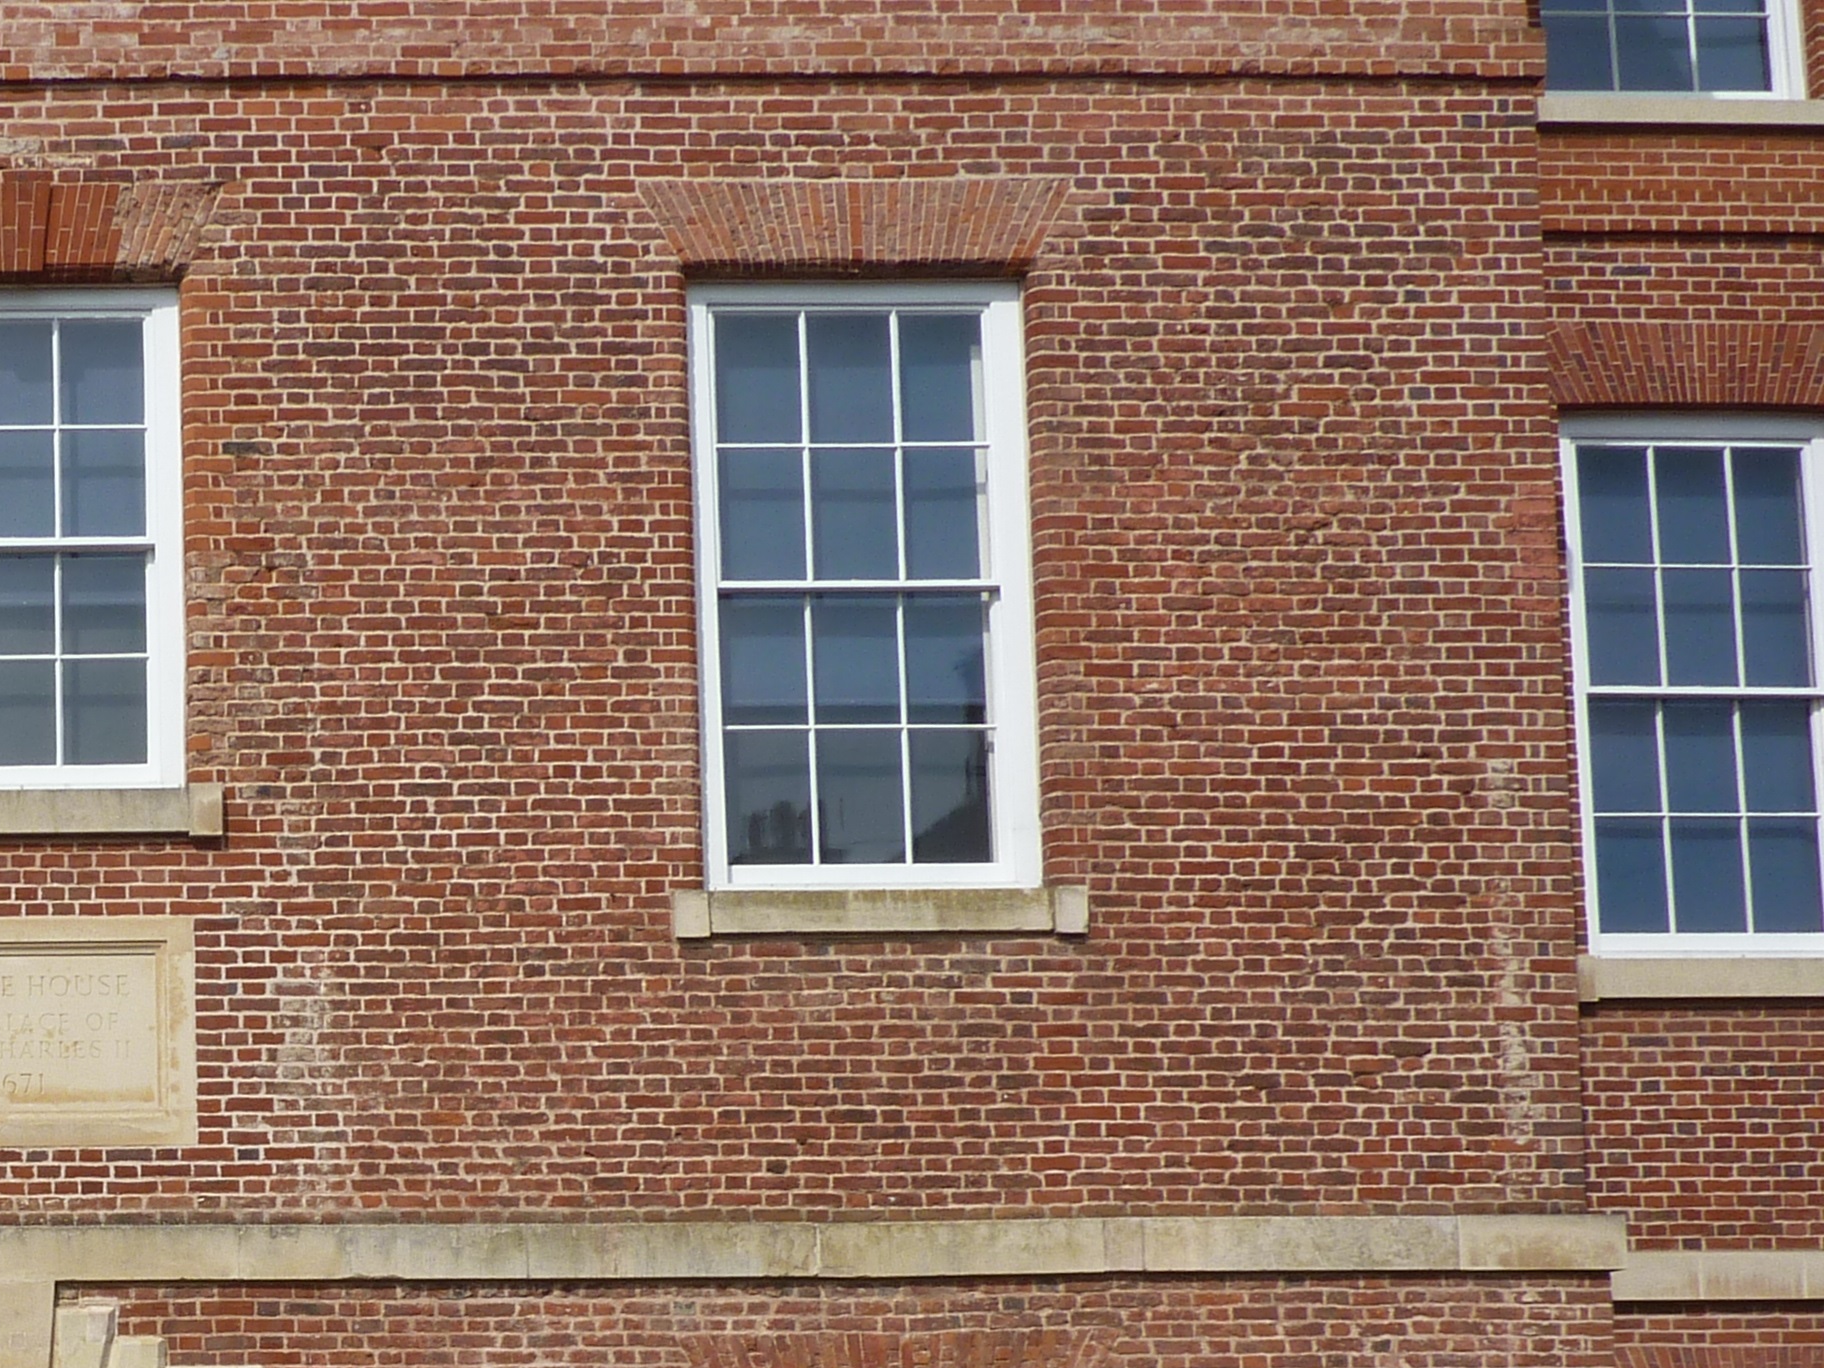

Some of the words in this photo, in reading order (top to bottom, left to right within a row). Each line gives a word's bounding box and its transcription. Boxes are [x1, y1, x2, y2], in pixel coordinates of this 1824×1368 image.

[28, 974, 130, 996] HOUSE
[85, 1012, 118, 1031] OF
[115, 1040, 131, 1059] II
